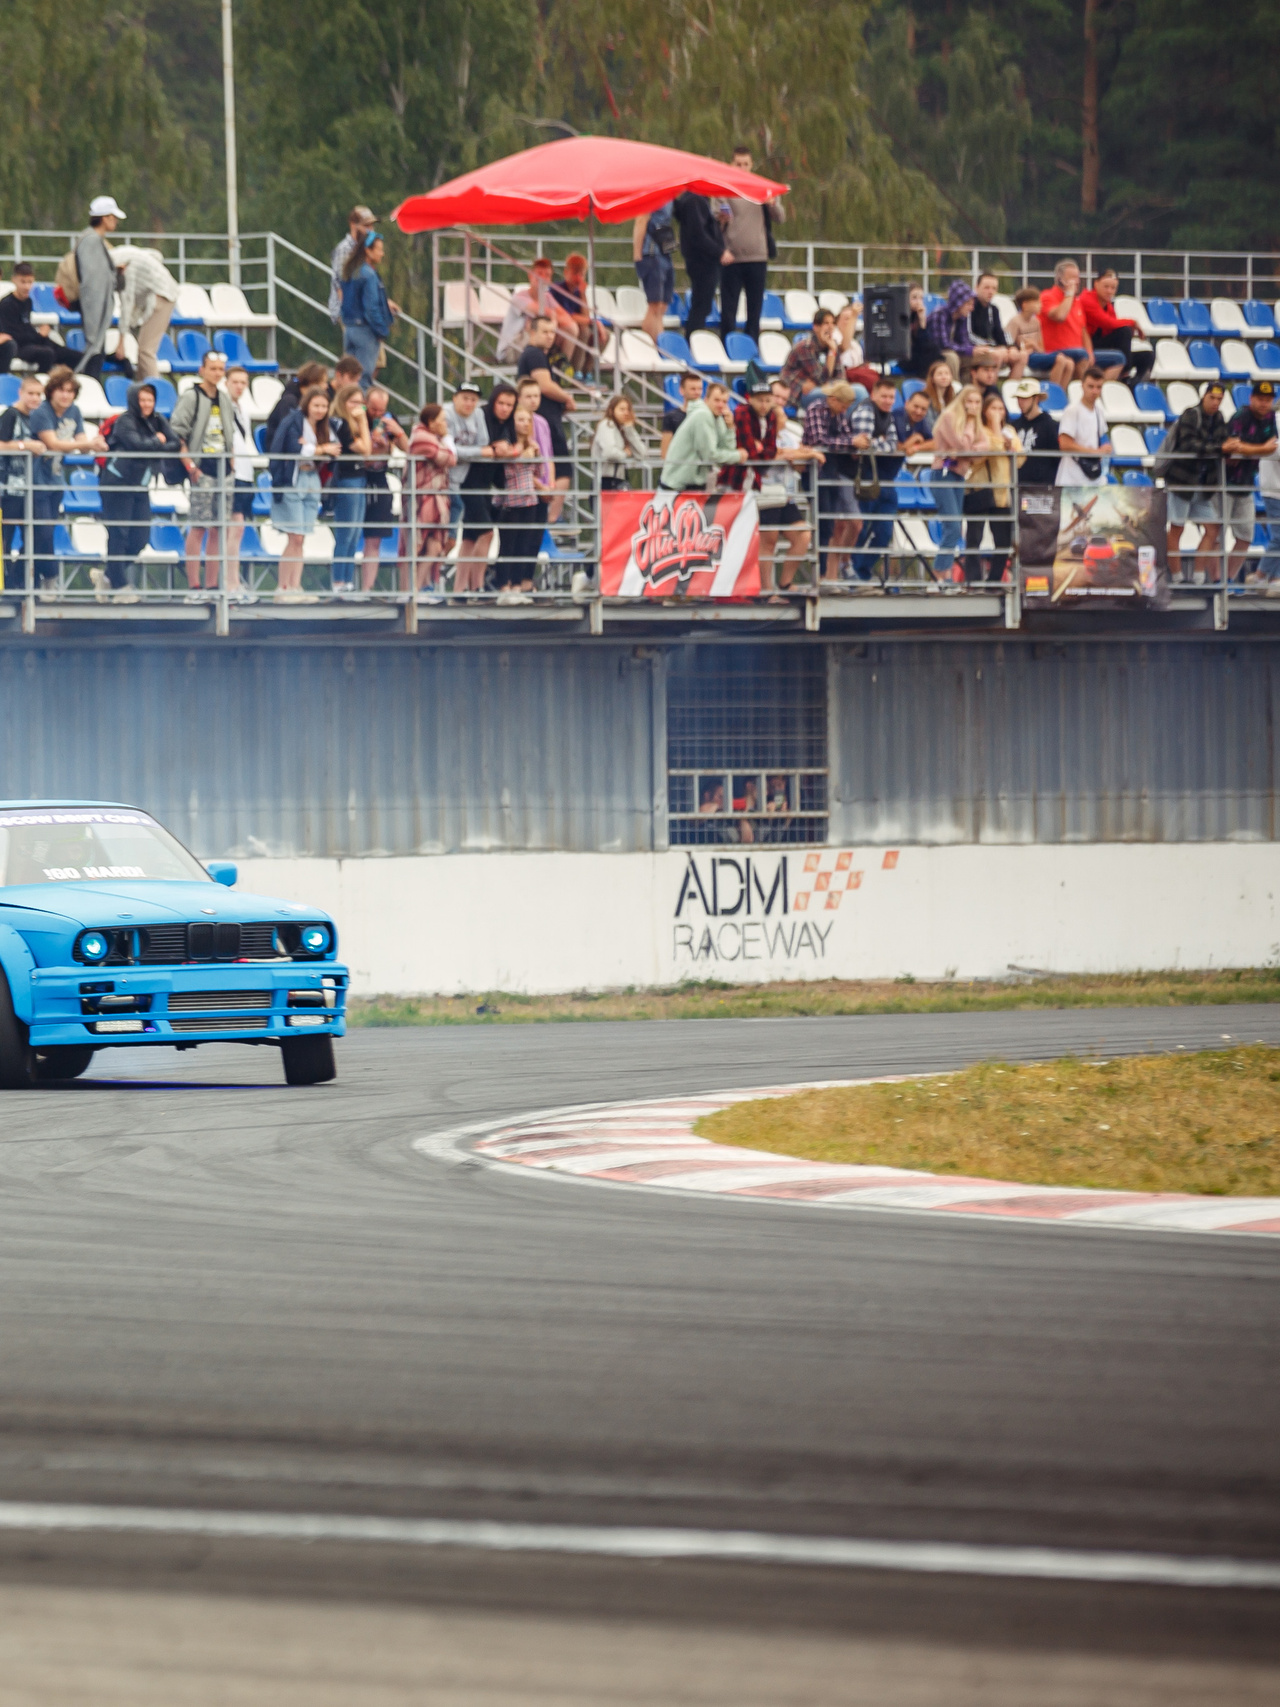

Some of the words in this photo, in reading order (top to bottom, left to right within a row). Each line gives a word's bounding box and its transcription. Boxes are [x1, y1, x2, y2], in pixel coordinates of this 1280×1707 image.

[52, 814, 104, 824] DRIFT
[104, 814, 140, 824] CUP
[674, 854, 789, 917] ADM
[673, 920, 834, 961] RACEWAY
